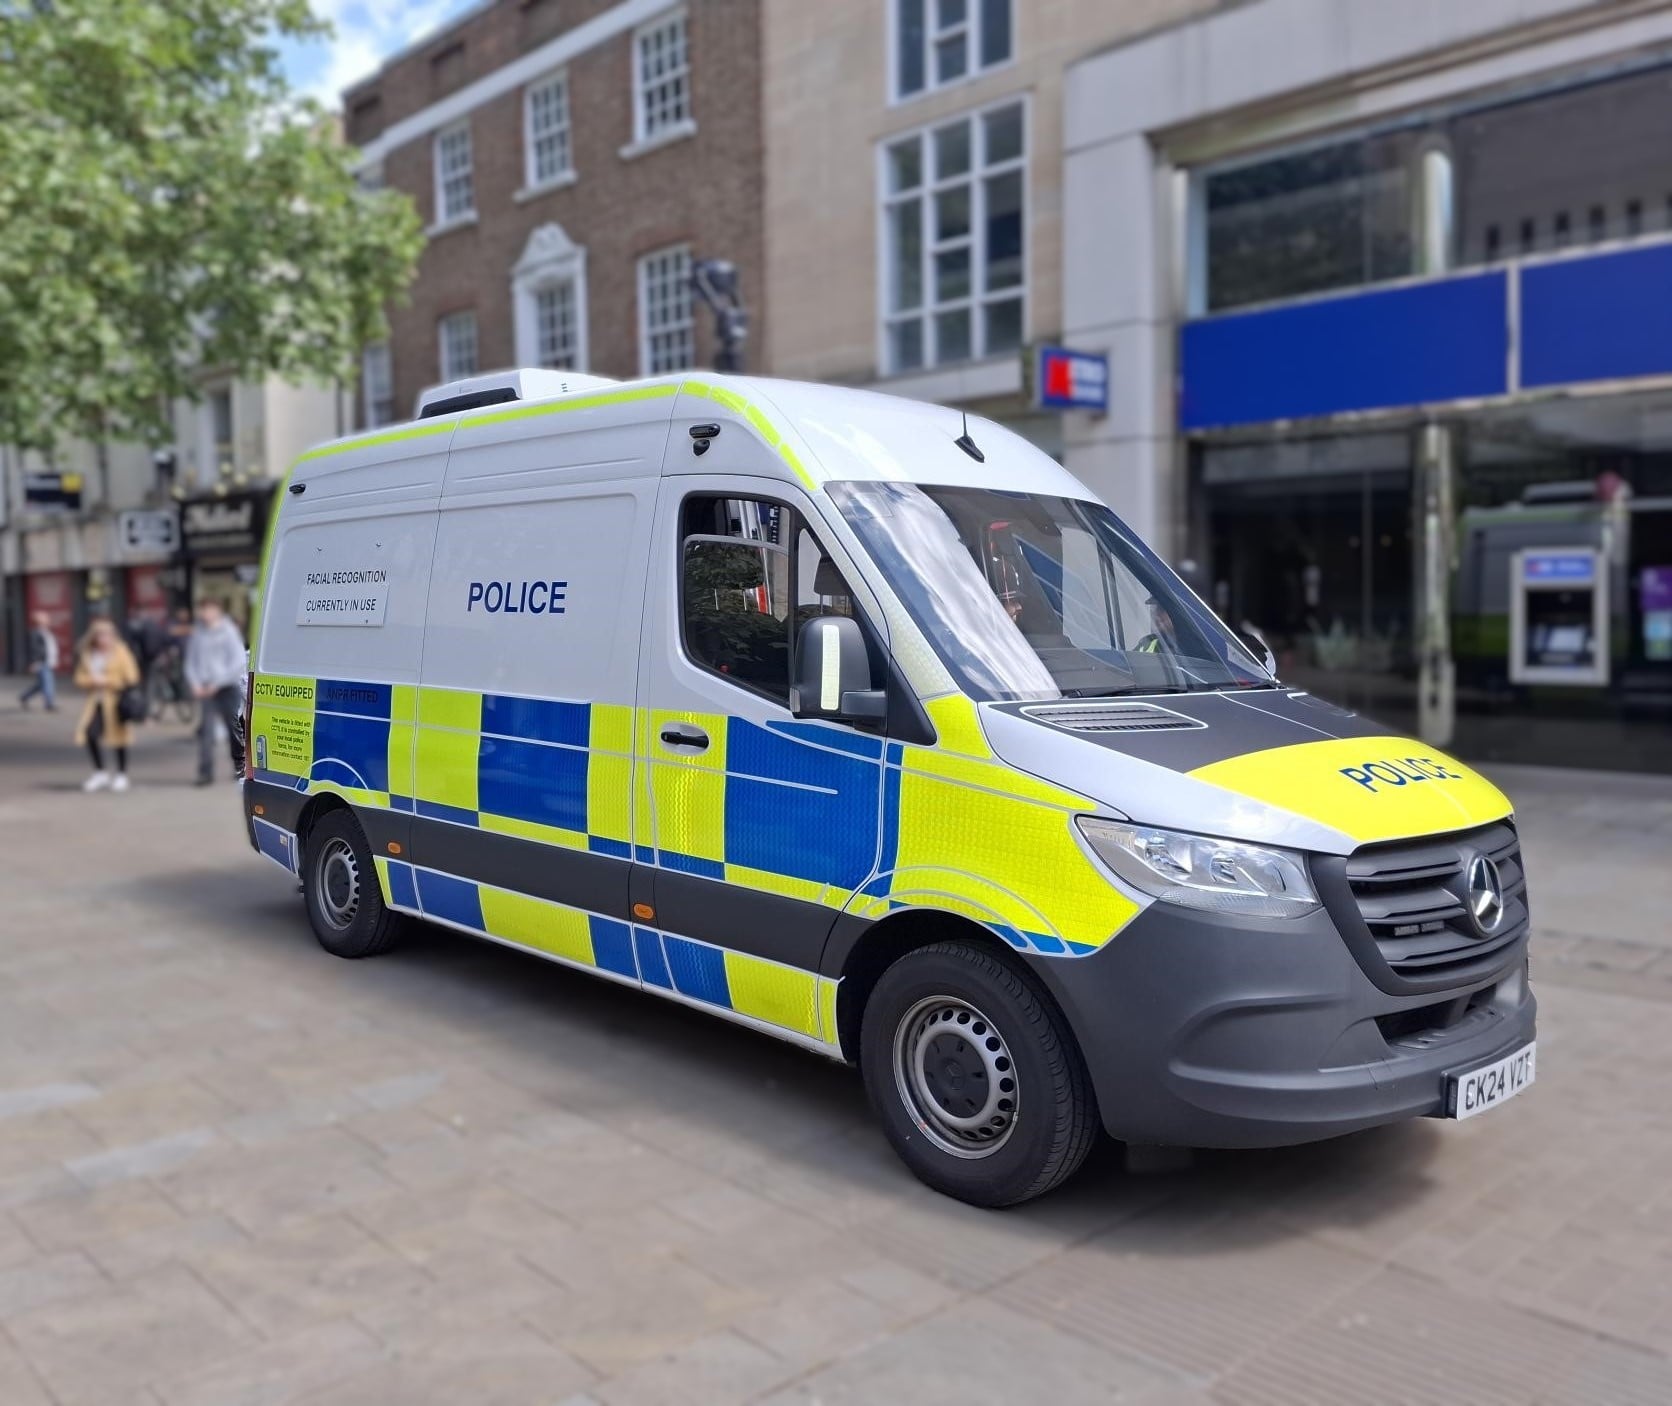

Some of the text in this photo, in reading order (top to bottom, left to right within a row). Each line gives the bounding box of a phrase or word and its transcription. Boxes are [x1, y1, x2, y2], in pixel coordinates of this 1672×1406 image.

[307, 570, 386, 585] FACIAL RECOGNITION
[306, 599, 377, 611] CURRENTLY IN USE
[467, 581, 568, 614] POLICE
[255, 682, 313, 699] CCTV EQUIPPED
[1338, 758, 1463, 792] POLICE
[1466, 1051, 1531, 1110] CK24 VZT
